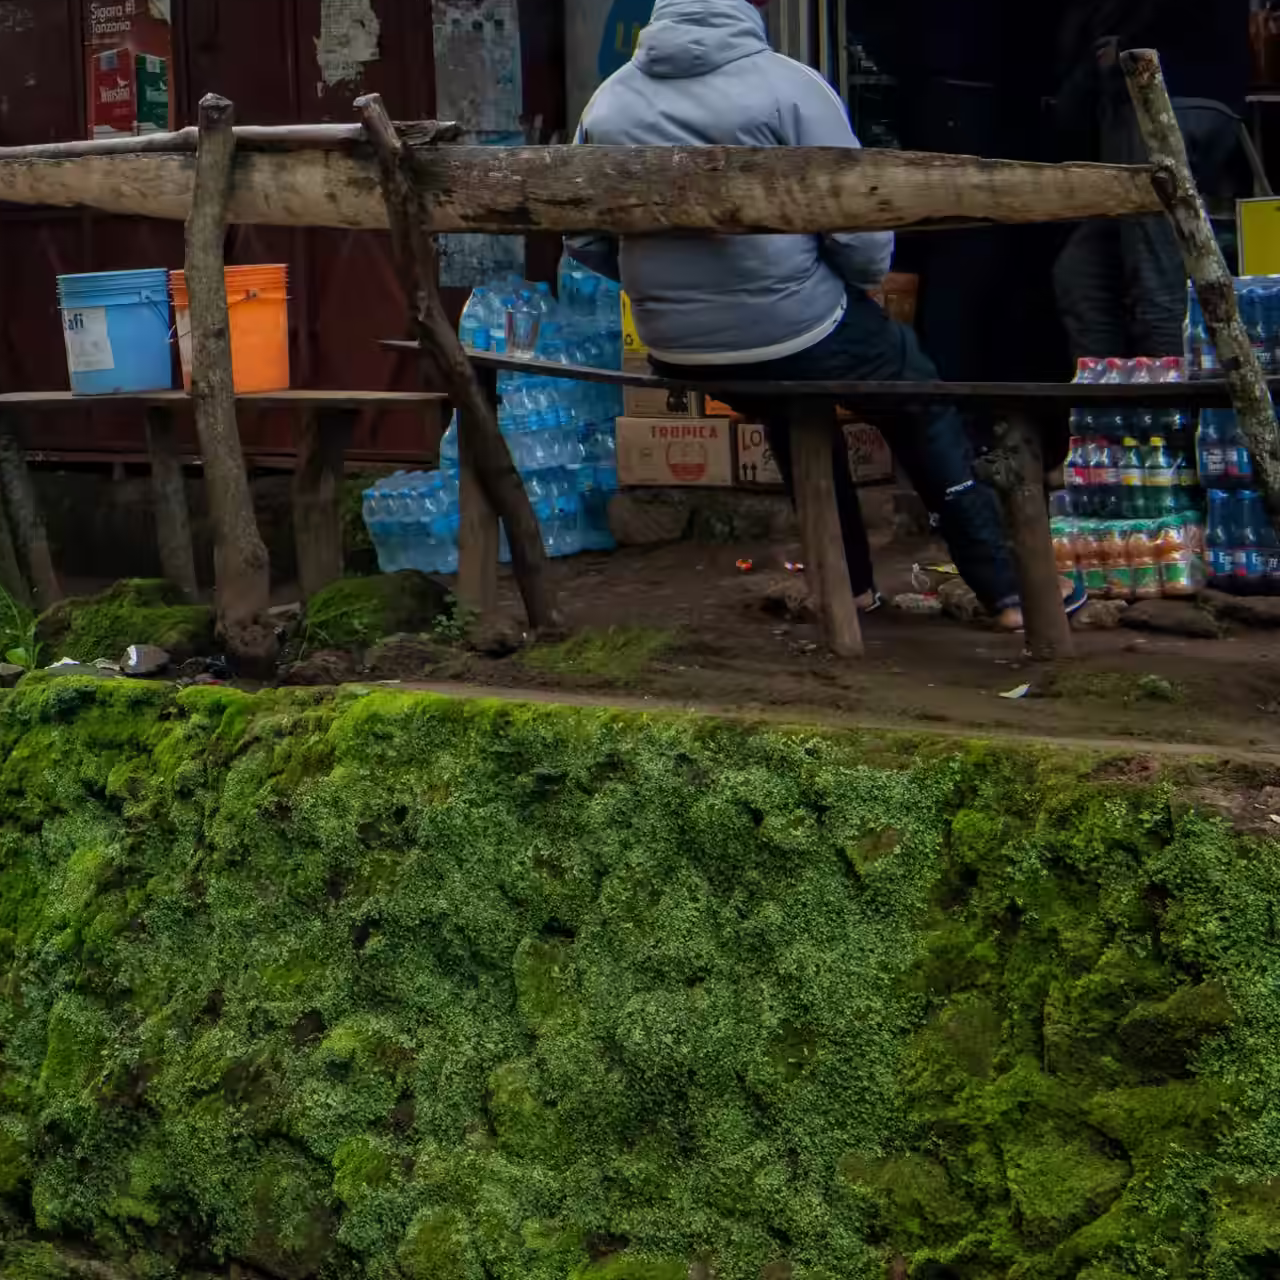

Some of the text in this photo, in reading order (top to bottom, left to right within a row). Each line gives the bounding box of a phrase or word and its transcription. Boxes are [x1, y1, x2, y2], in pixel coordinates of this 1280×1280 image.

[90, 2, 122, 21] Sigara
[90, 18, 131, 34] Tanzania
[99, 86, 130, 104] Winston
[649, 425, 719, 440] TROPICA
